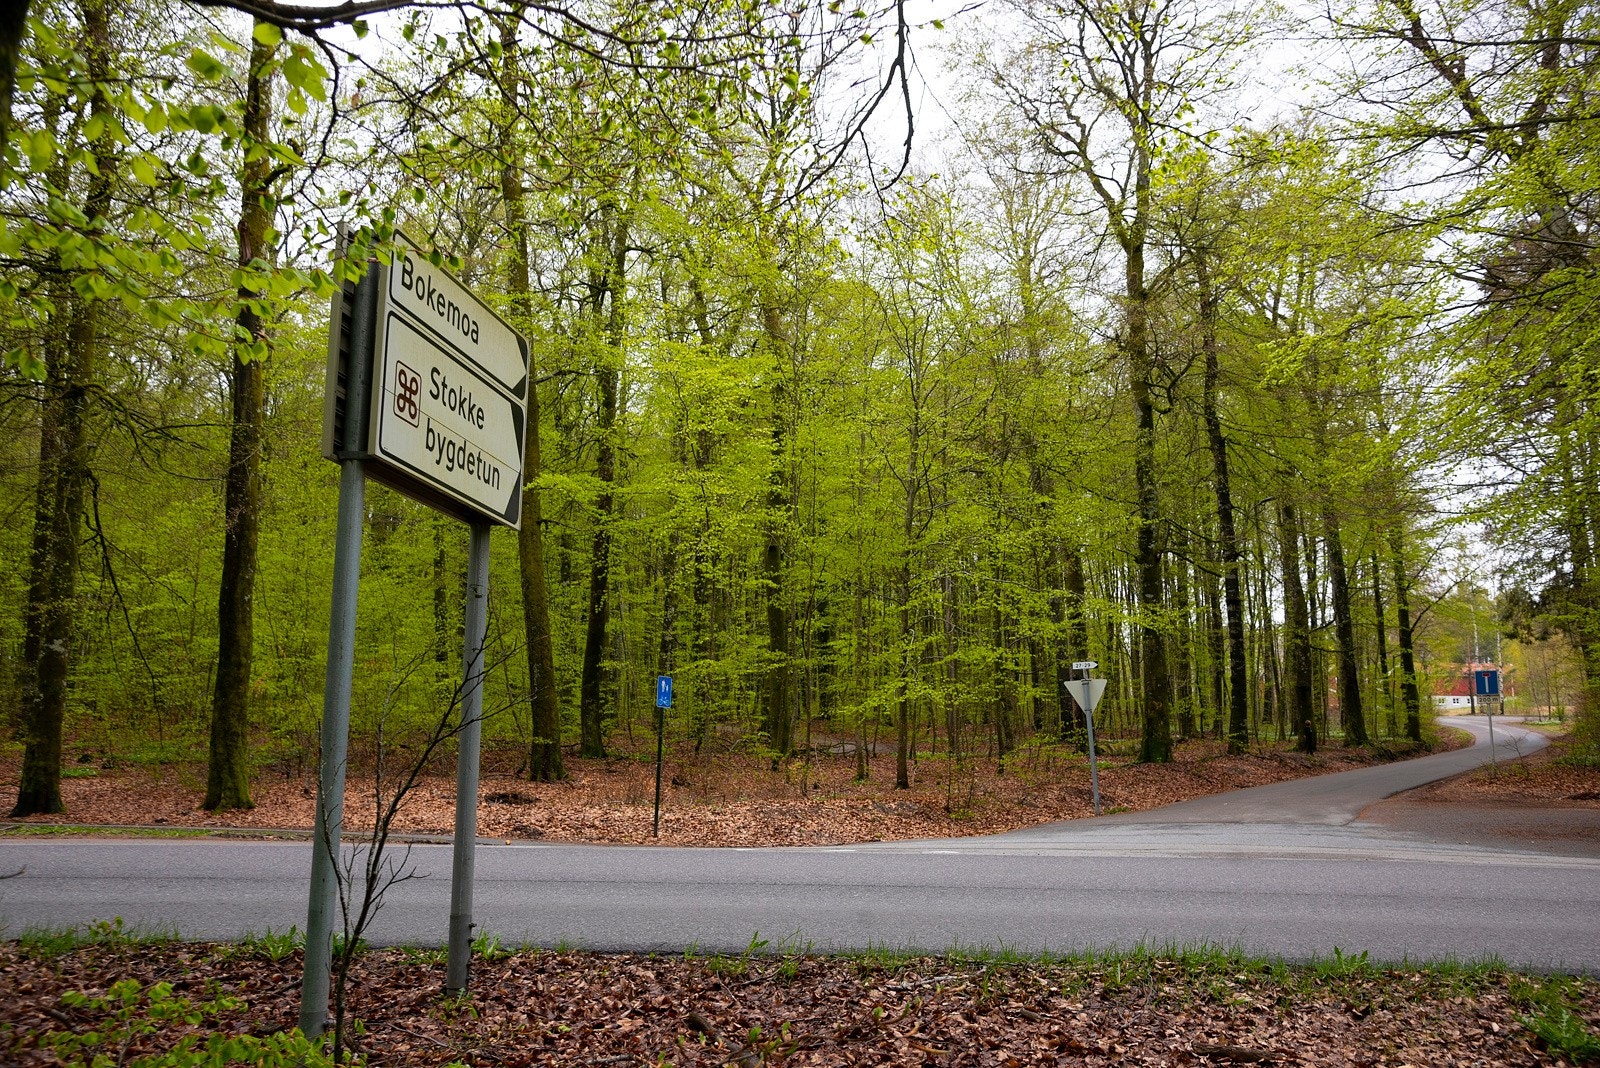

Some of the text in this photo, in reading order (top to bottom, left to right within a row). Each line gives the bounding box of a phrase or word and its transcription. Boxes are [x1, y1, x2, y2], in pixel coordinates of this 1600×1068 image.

[401, 256, 480, 345] Bokemoa
[429, 366, 485, 430] Stokke
[425, 418, 500, 491] bygdetun
